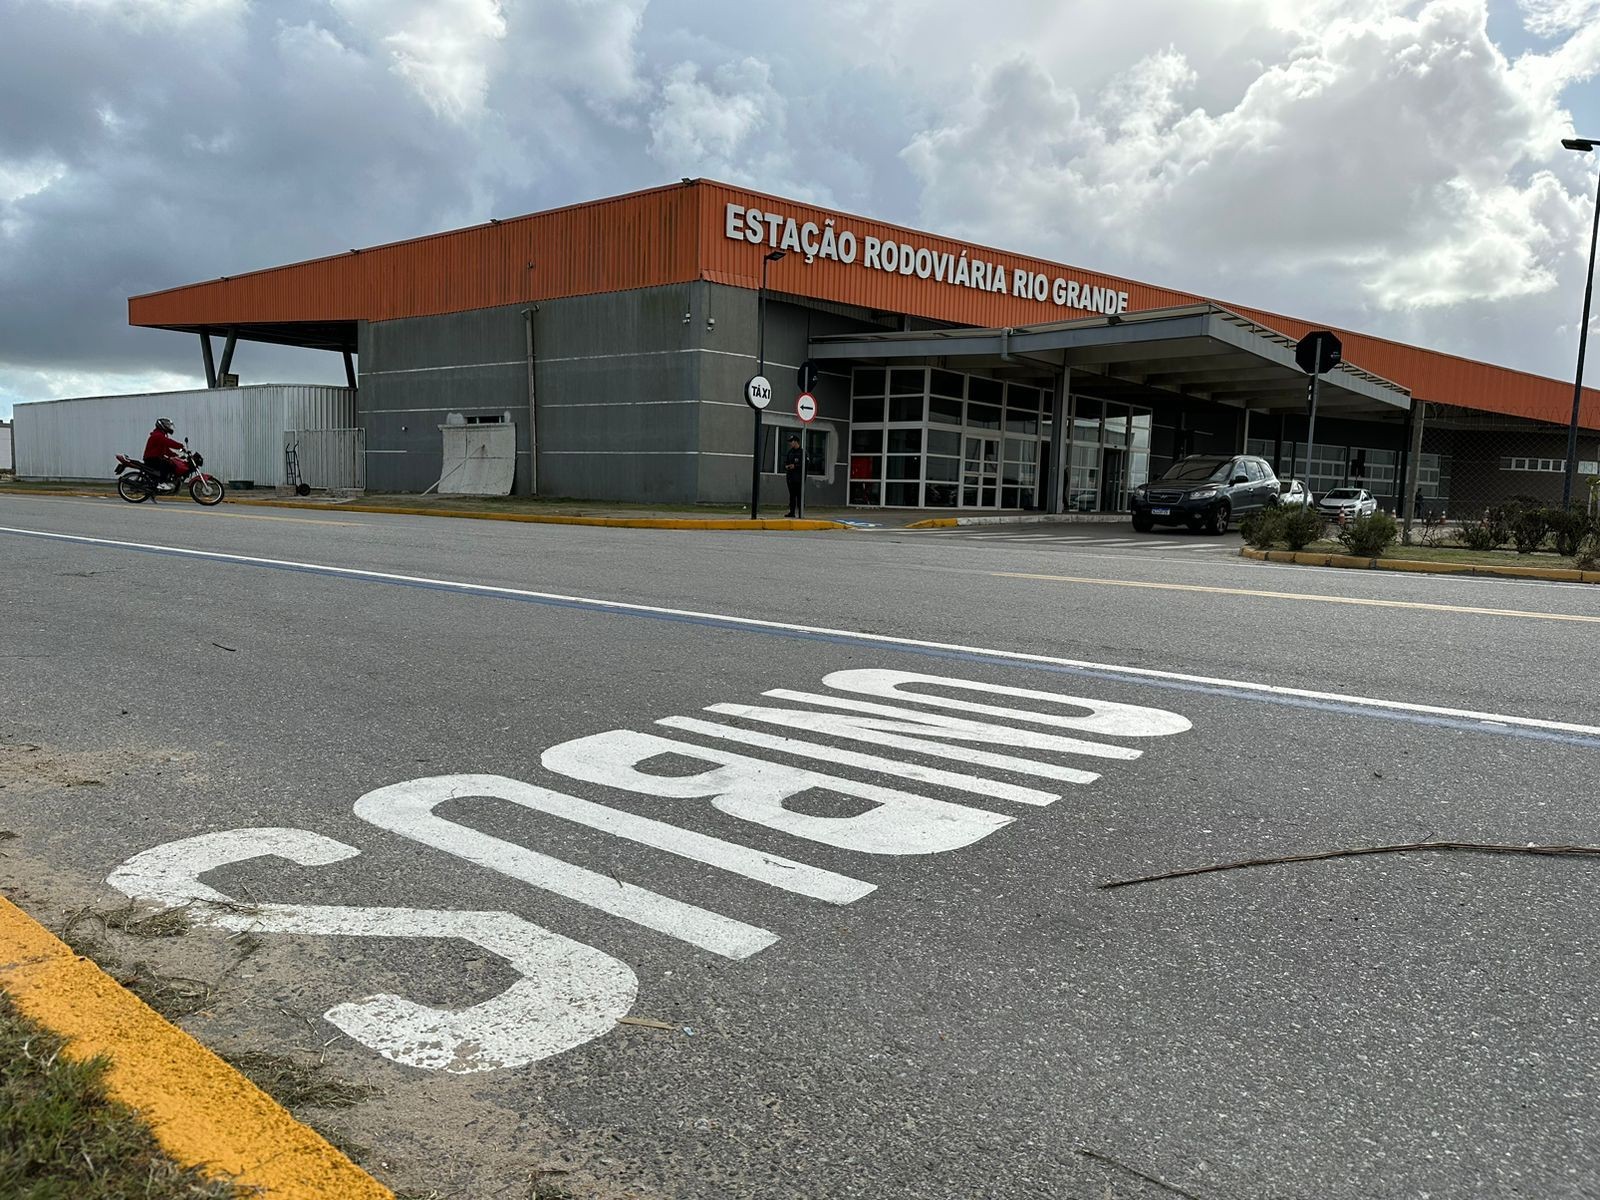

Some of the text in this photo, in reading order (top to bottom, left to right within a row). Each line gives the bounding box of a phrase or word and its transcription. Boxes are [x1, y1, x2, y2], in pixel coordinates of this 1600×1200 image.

[726, 203, 1128, 315] ESTAÇÃO RODOVIÁRIA RIO GRANDE
[751, 384, 771, 400] TÁXI
